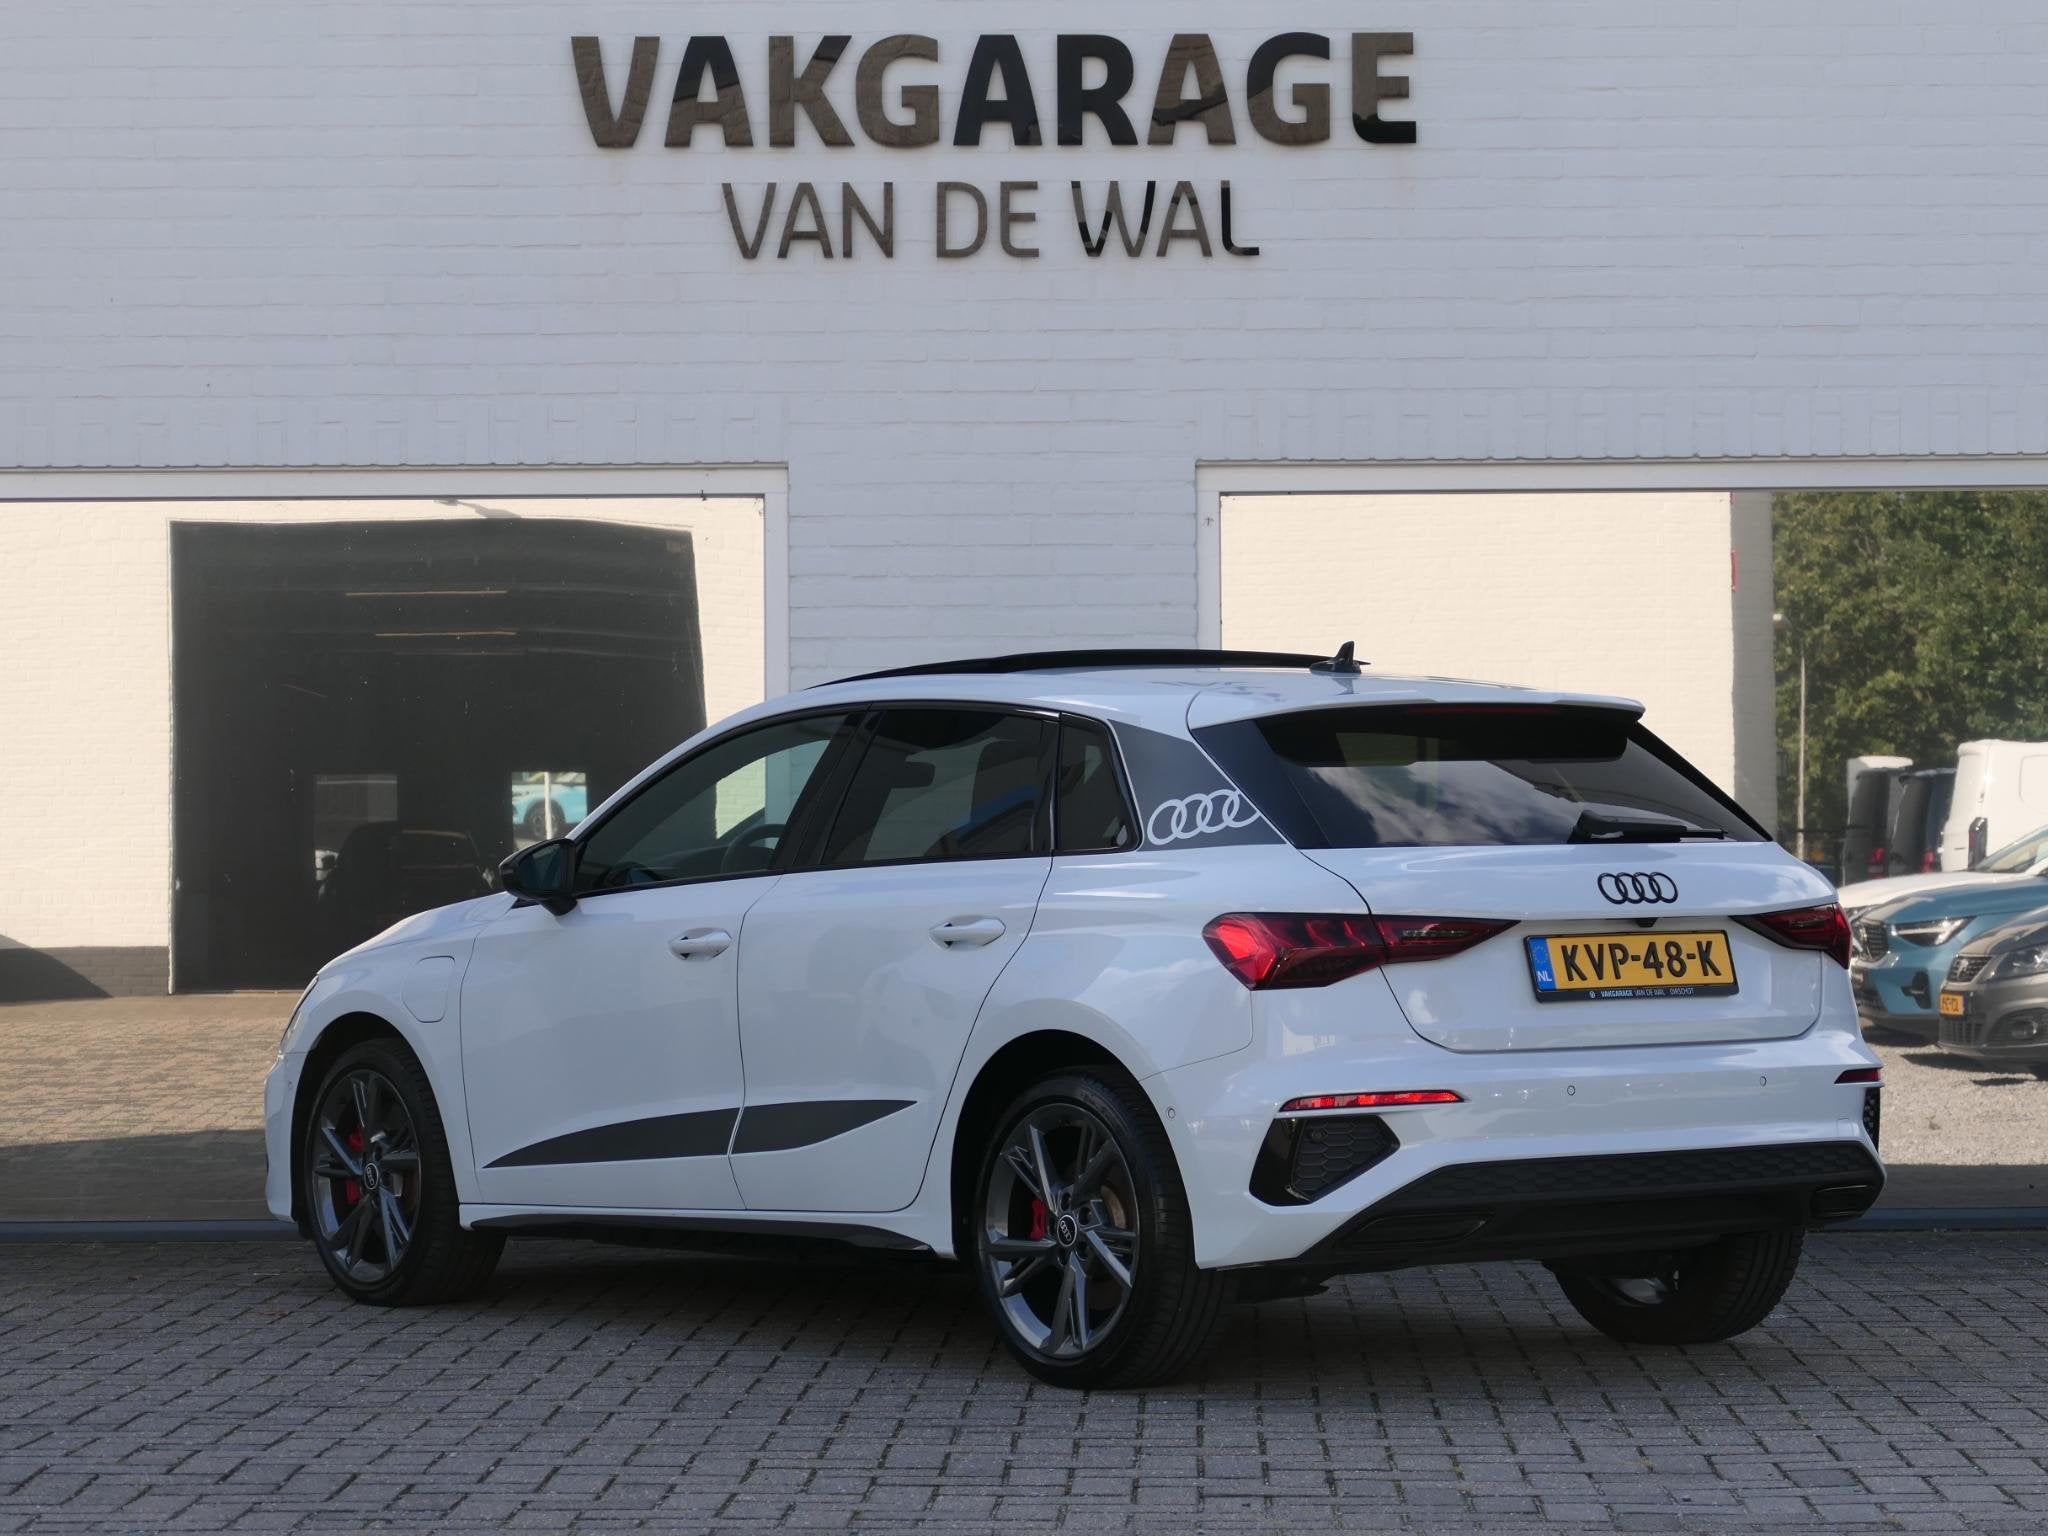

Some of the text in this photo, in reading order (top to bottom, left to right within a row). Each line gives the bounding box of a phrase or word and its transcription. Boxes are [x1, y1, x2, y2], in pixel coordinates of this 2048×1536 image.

[571, 32, 1417, 150] VAKGARAGE
[722, 180, 1259, 260] VAN DE WAL
[1537, 970, 1552, 983] NL
[1560, 940, 1722, 982] KVP-48-K
[1601, 989, 1633, 998] VAKGARAGE
